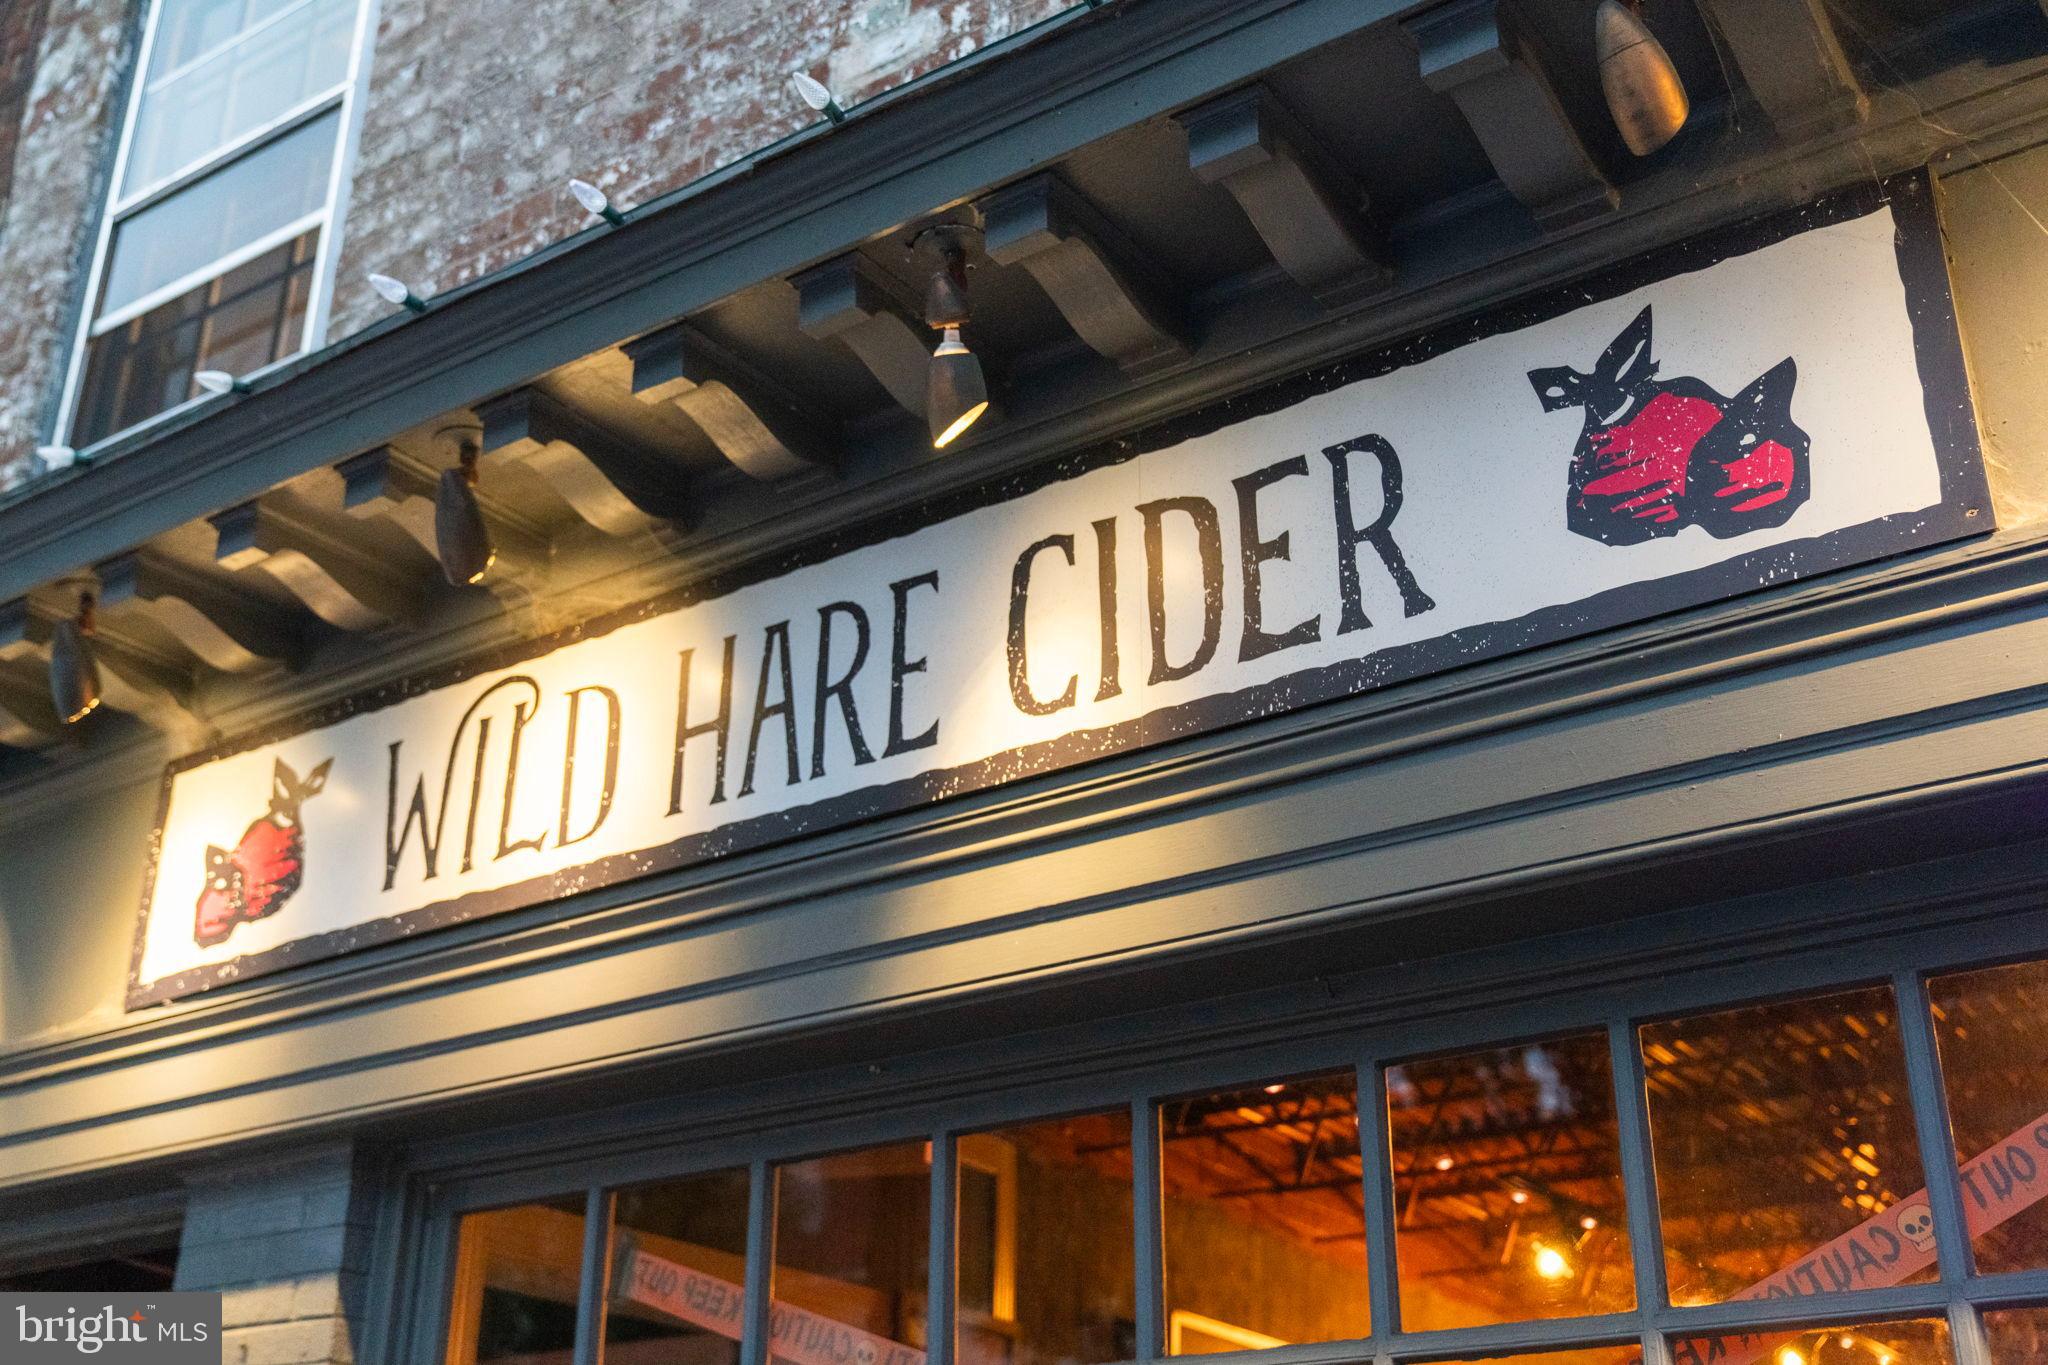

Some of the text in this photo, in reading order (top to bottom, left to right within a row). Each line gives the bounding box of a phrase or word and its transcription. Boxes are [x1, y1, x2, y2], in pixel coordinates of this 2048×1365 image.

[382, 433, 1436, 892] WILD HARE CIDER
